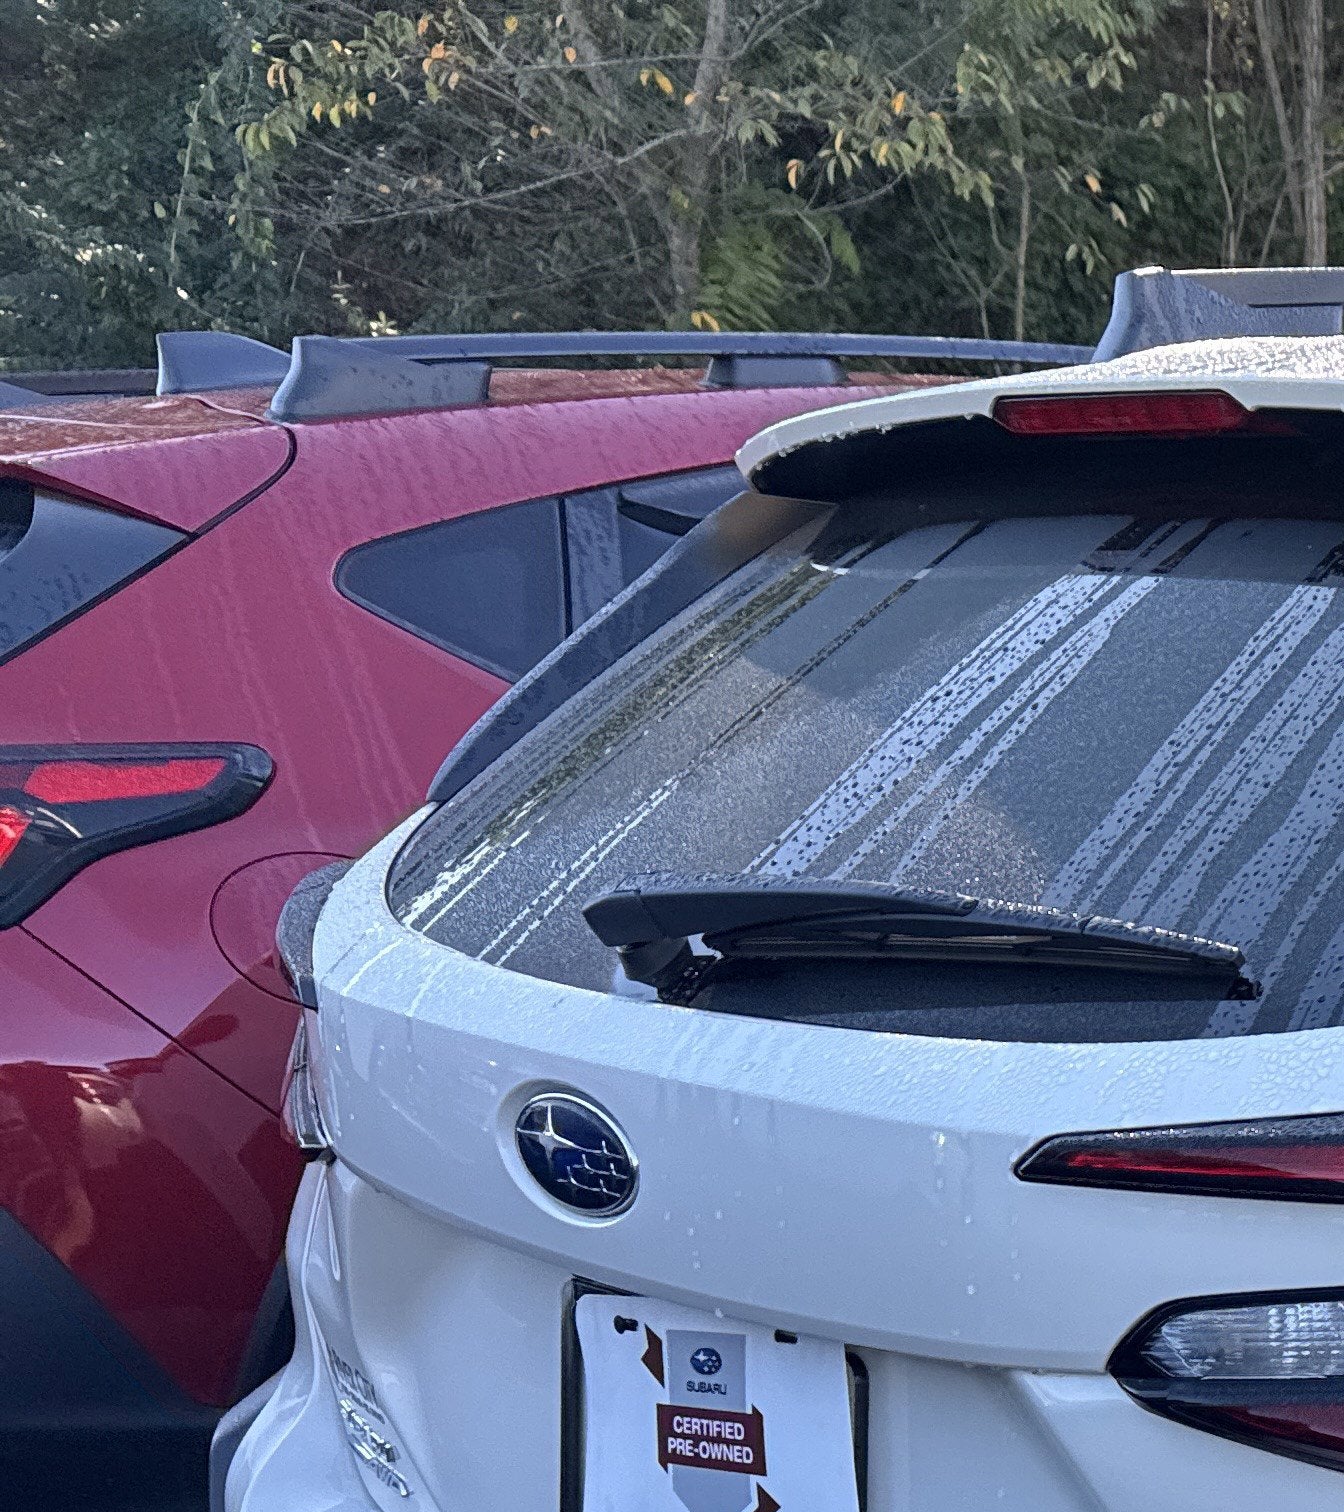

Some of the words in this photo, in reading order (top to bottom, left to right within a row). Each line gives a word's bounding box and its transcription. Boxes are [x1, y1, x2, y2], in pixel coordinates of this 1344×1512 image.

[685, 1379, 728, 1396] SUBARU
[672, 1415, 745, 1441] CERTIFIED
[667, 1436, 754, 1464] PRE-OWNED
